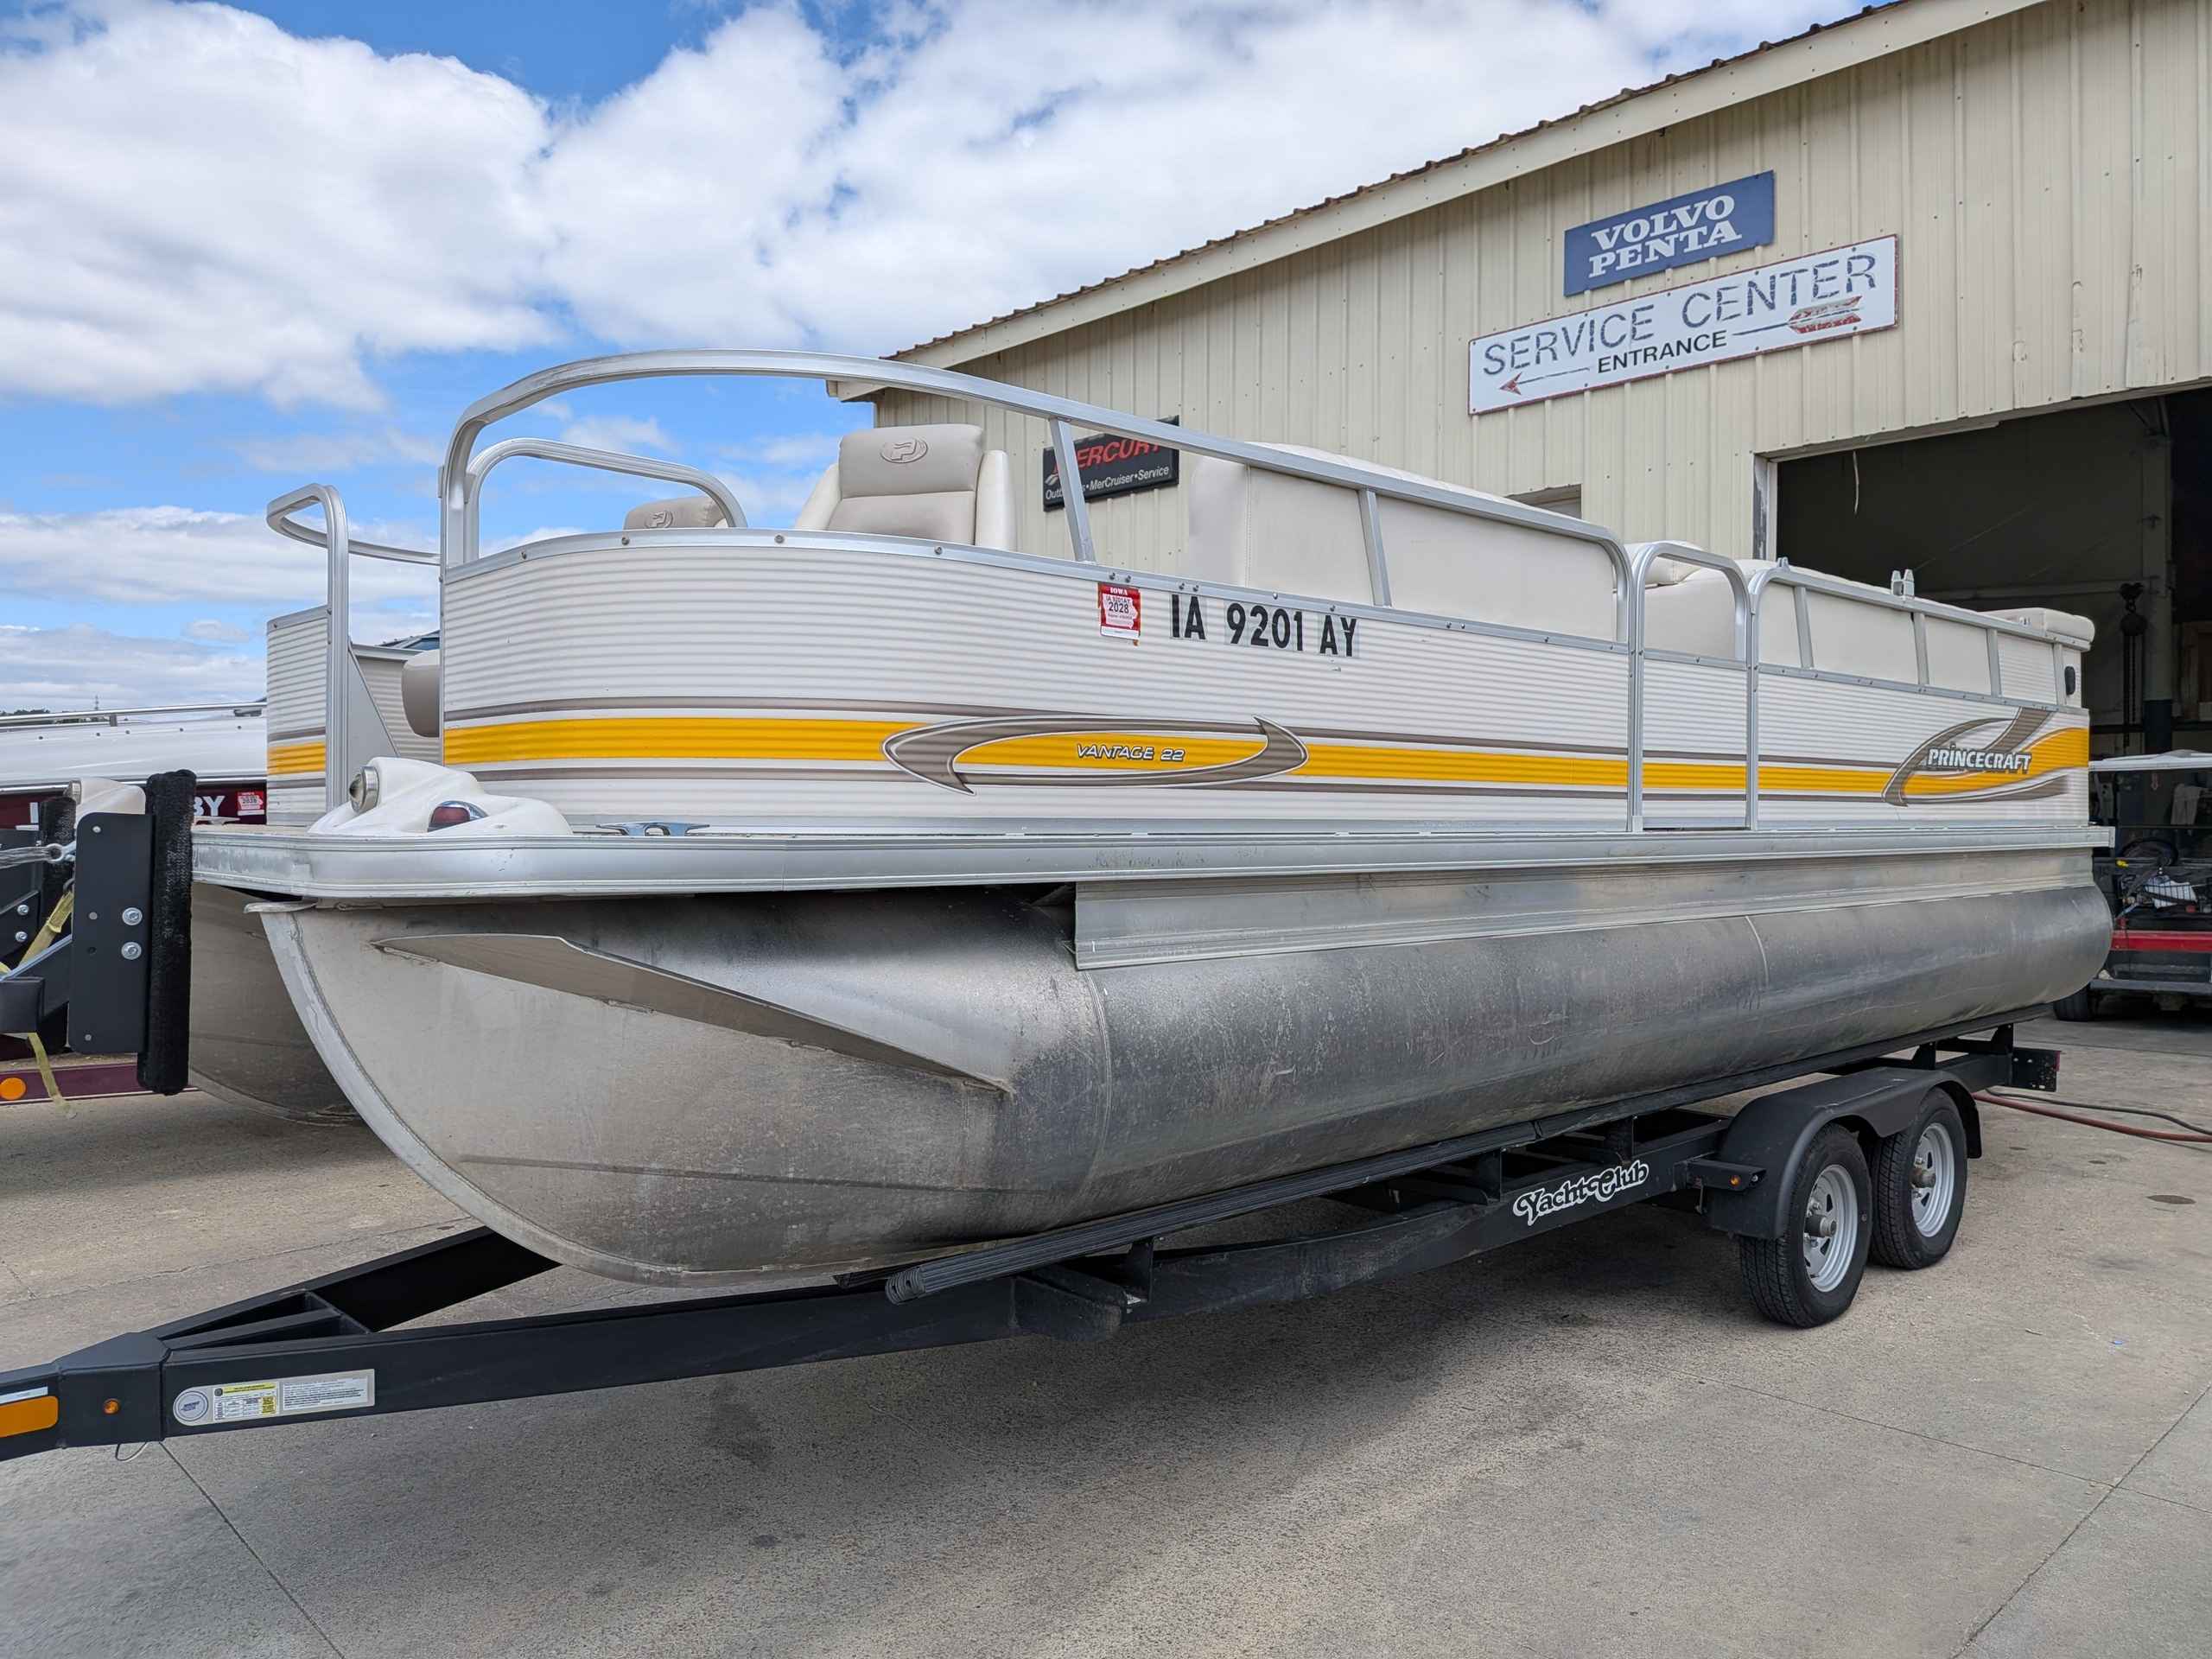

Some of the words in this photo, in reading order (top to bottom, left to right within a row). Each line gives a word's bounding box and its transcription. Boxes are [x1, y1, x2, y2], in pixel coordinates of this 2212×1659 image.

[1591, 194, 1735, 251] VOLVO
[1588, 220, 1743, 278] PENTA
[1483, 303, 1654, 377] SERVICE
[1681, 254, 1877, 328] CENTER
[1598, 329, 1727, 373] ENTRANCE
[1138, 465, 1170, 480] Service
[1108, 601, 1129, 613] 2028
[1172, 594, 1206, 639] IA
[1226, 602, 1303, 652] 9201
[1319, 614, 1357, 657] AY
[1077, 744, 1154, 760] VANTAGE
[1160, 747, 1185, 761] 22
[1928, 748, 2031, 770] PRINCECRAFT
